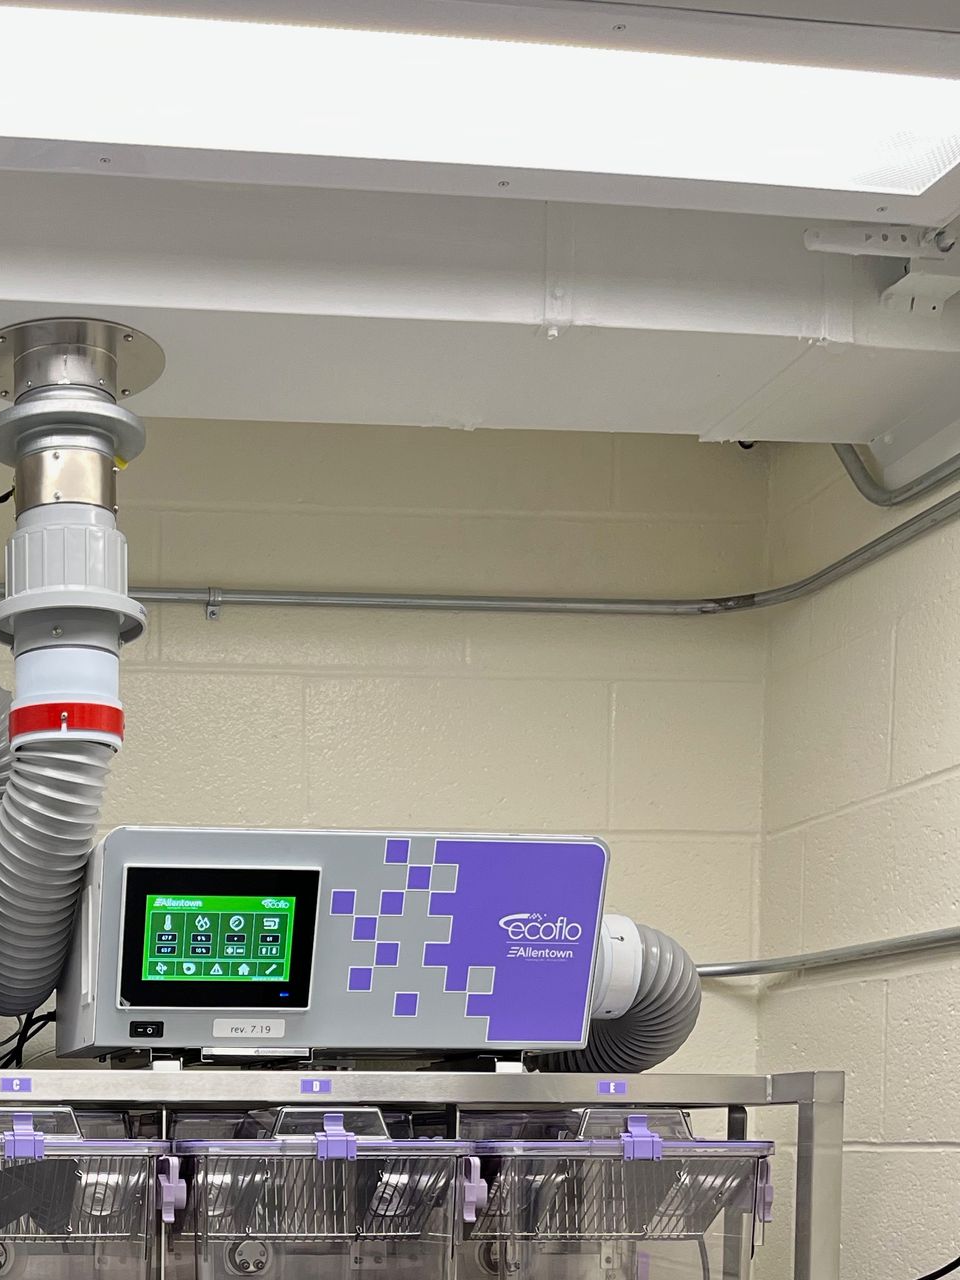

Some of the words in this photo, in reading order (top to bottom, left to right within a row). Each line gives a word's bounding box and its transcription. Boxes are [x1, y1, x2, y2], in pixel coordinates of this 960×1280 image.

[504, 915, 582, 941] ecoflo
[516, 946, 573, 959] Allentown
[230, 1026, 247, 1034] rev.
[250, 1025, 271, 1034] 7.19
[12, 1079, 20, 1091] C
[312, 1080, 320, 1092] D
[609, 1082, 616, 1093] E
